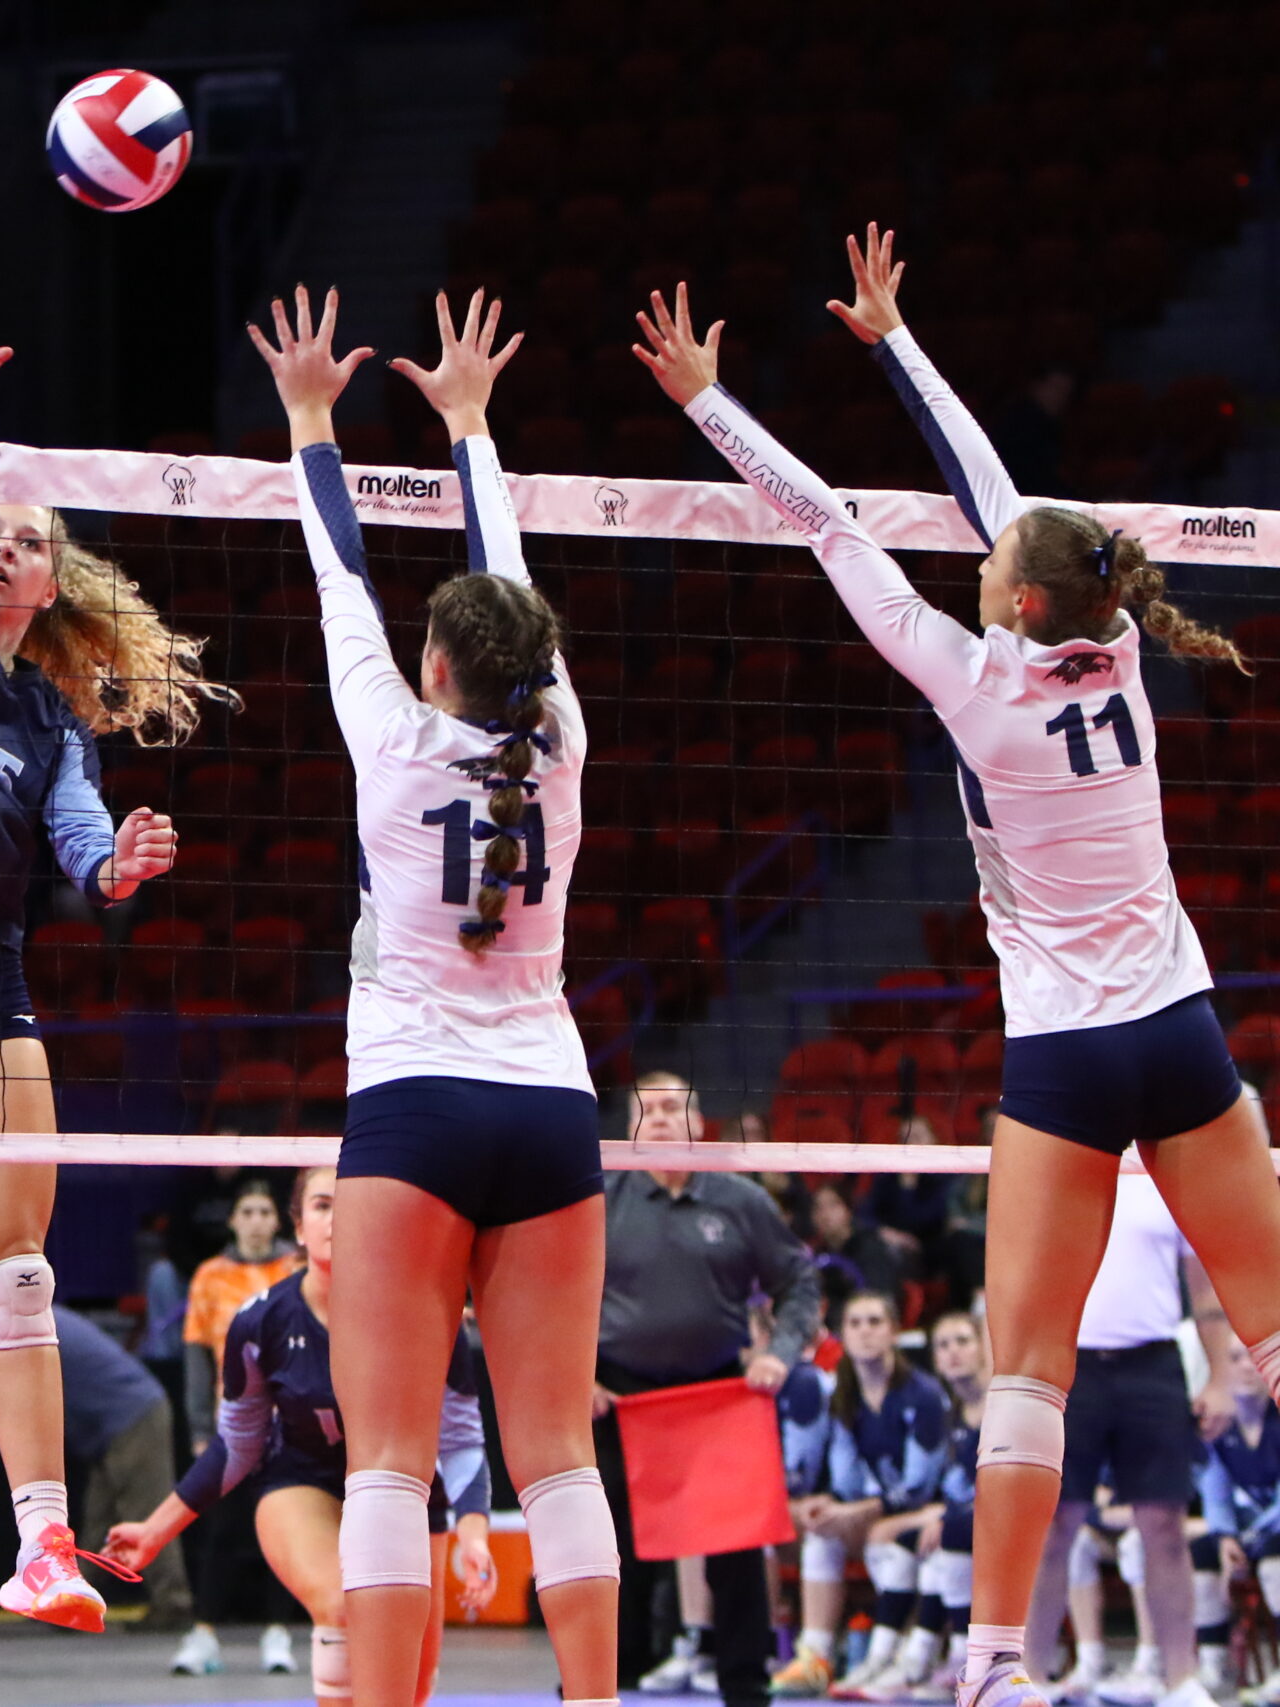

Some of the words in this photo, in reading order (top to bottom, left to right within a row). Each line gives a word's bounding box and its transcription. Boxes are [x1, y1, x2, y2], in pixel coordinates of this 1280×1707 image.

[357, 475, 441, 499] molten
[702, 412, 830, 534] HAWKS
[353, 498, 371, 509] For
[372, 499, 389, 510] the
[410, 505, 441, 516] game
[1182, 515, 1256, 538] molten
[1045, 692, 1142, 778] 11
[421, 798, 551, 907] 14
